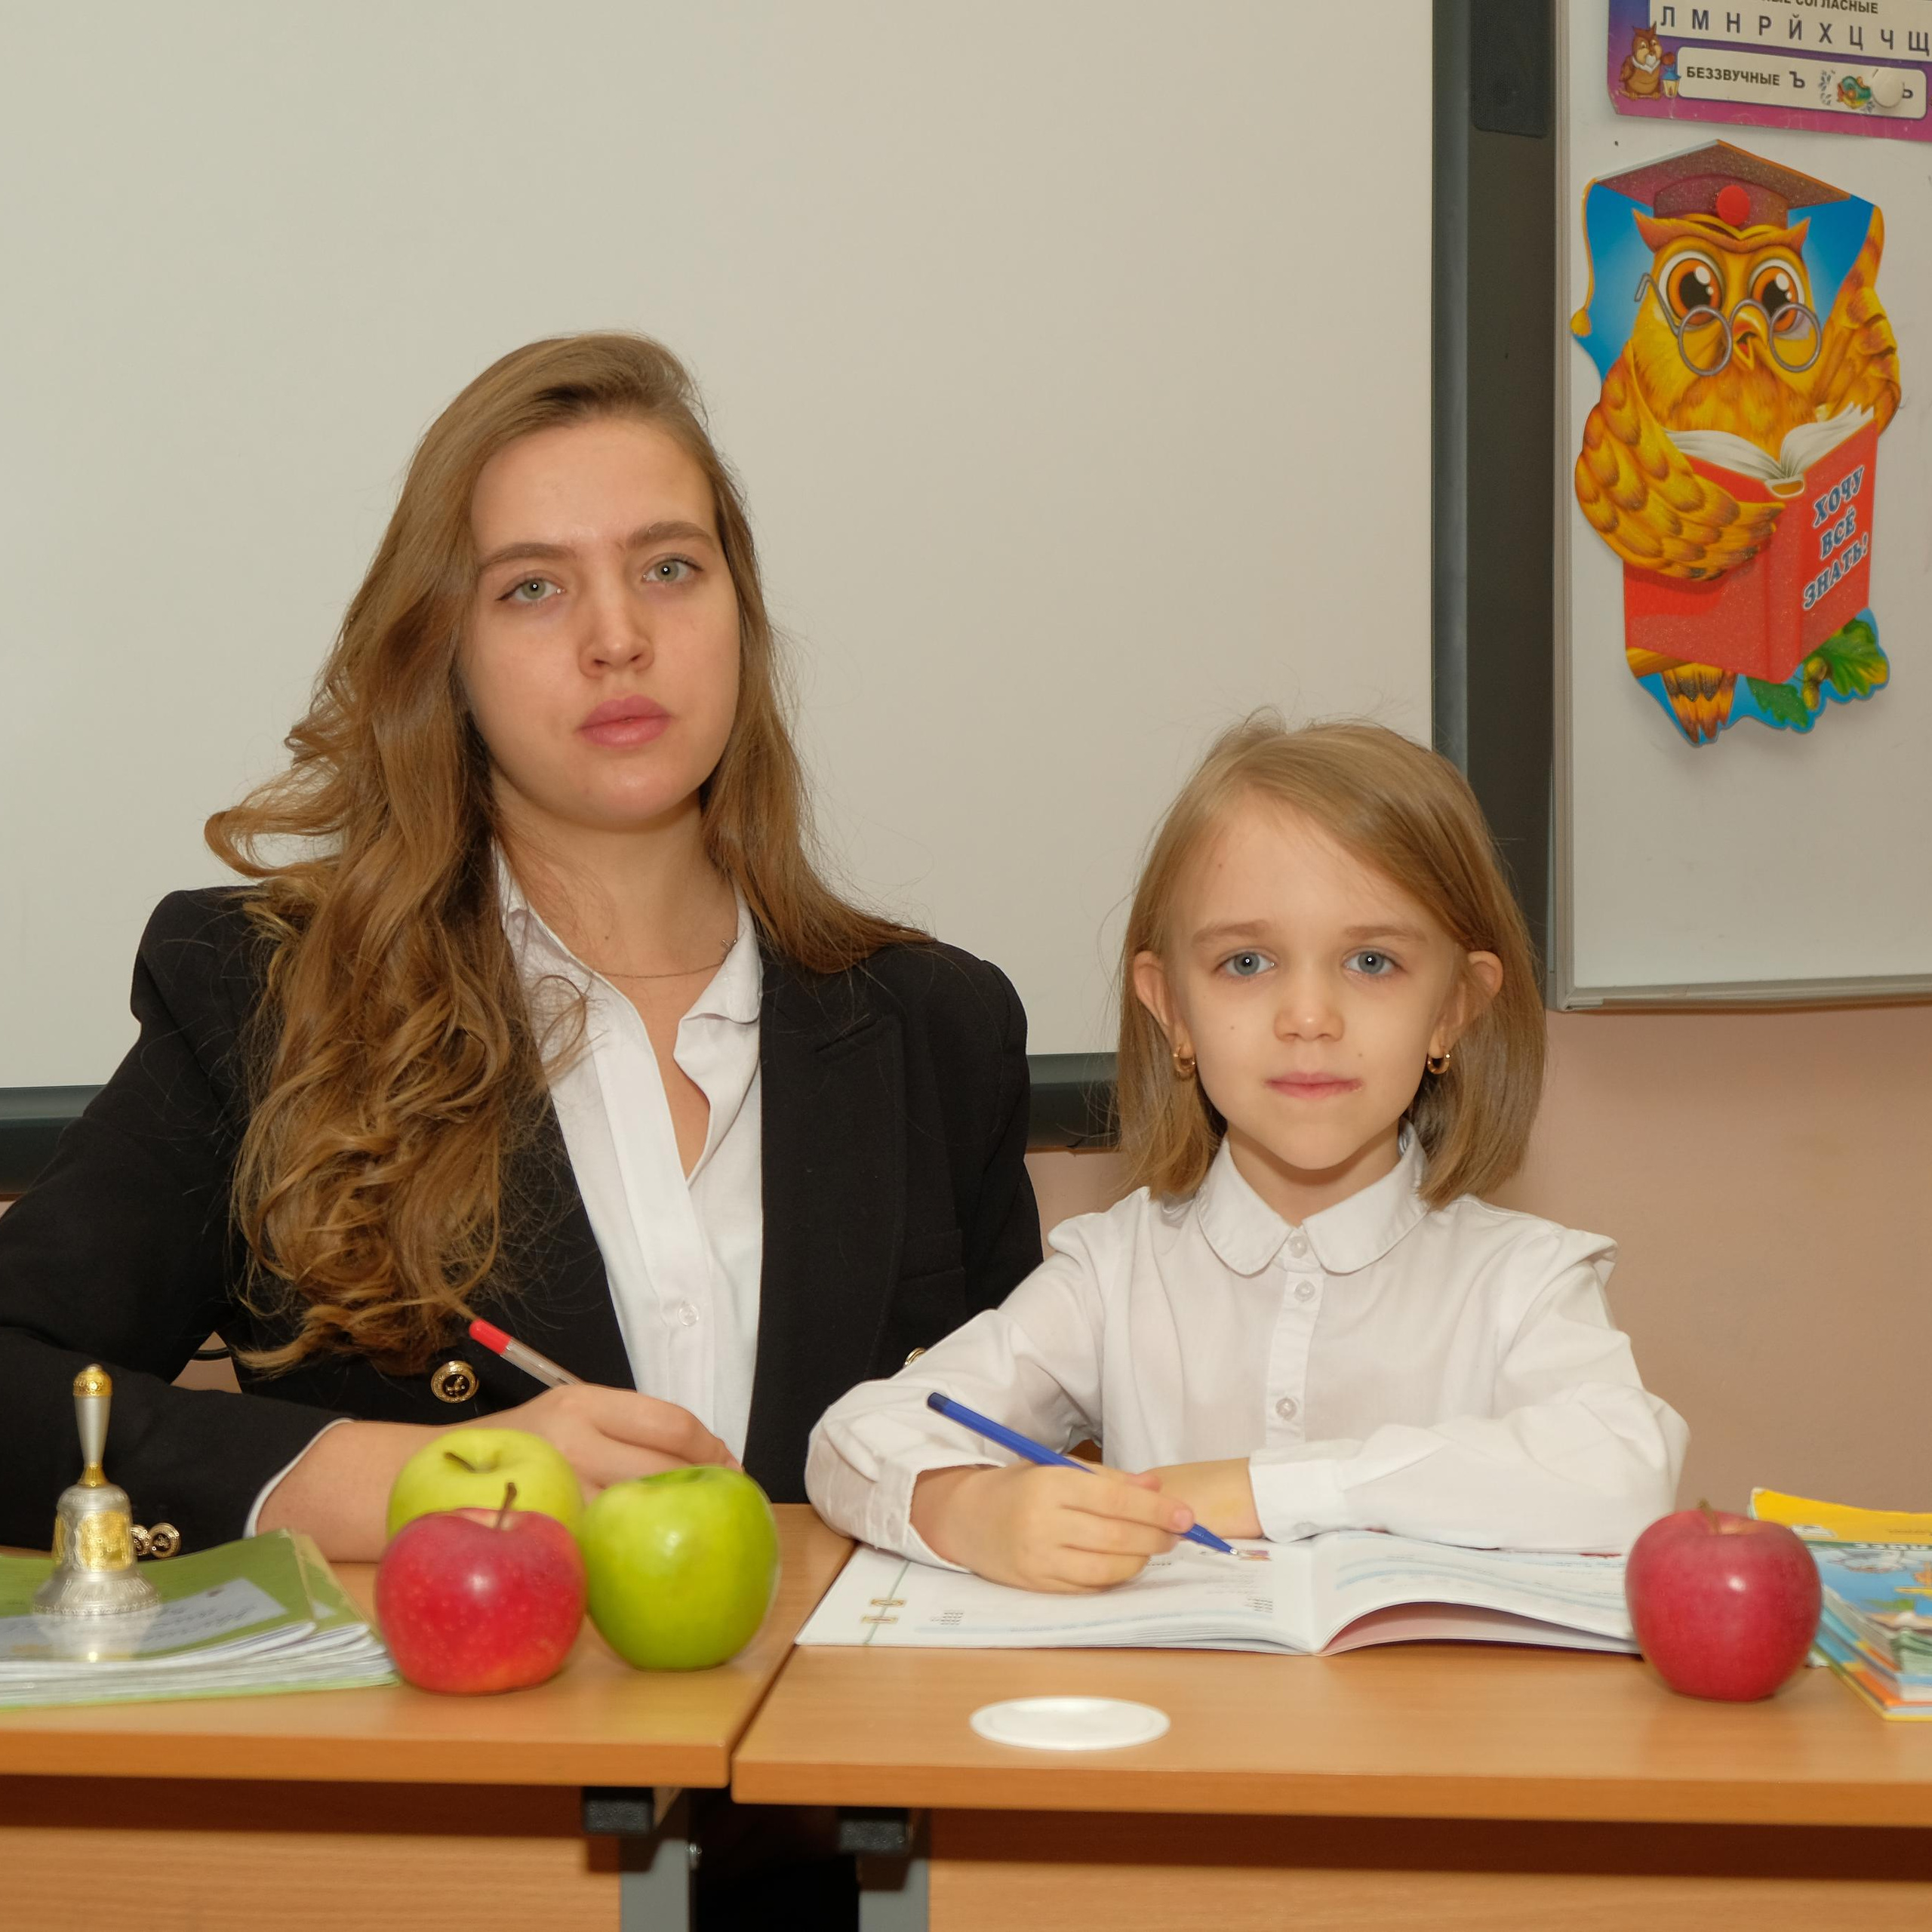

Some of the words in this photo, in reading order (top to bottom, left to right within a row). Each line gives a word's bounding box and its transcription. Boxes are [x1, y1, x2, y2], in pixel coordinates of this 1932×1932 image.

[1660, 5, 1675, 27] Л
[1692, 8, 1709, 30] М
[1727, 12, 1740, 33] Н
[1759, 15, 1771, 35] Р
[1789, 13, 1802, 41] Й
[1819, 22, 1832, 44] Х
[1850, 25, 1863, 51] Ц
[1881, 29, 1894, 50] Ч
[1909, 31, 1930, 57] Щ
[1686, 66, 1780, 86] БЕЗЗВУЧНЫЕ
[1789, 71, 1805, 88] Ъ
[1813, 465, 1865, 528] ХОЧУ
[1820, 505, 1856, 561] ВСЁ
[1802, 531, 1869, 611] ЗНАТЬ!
